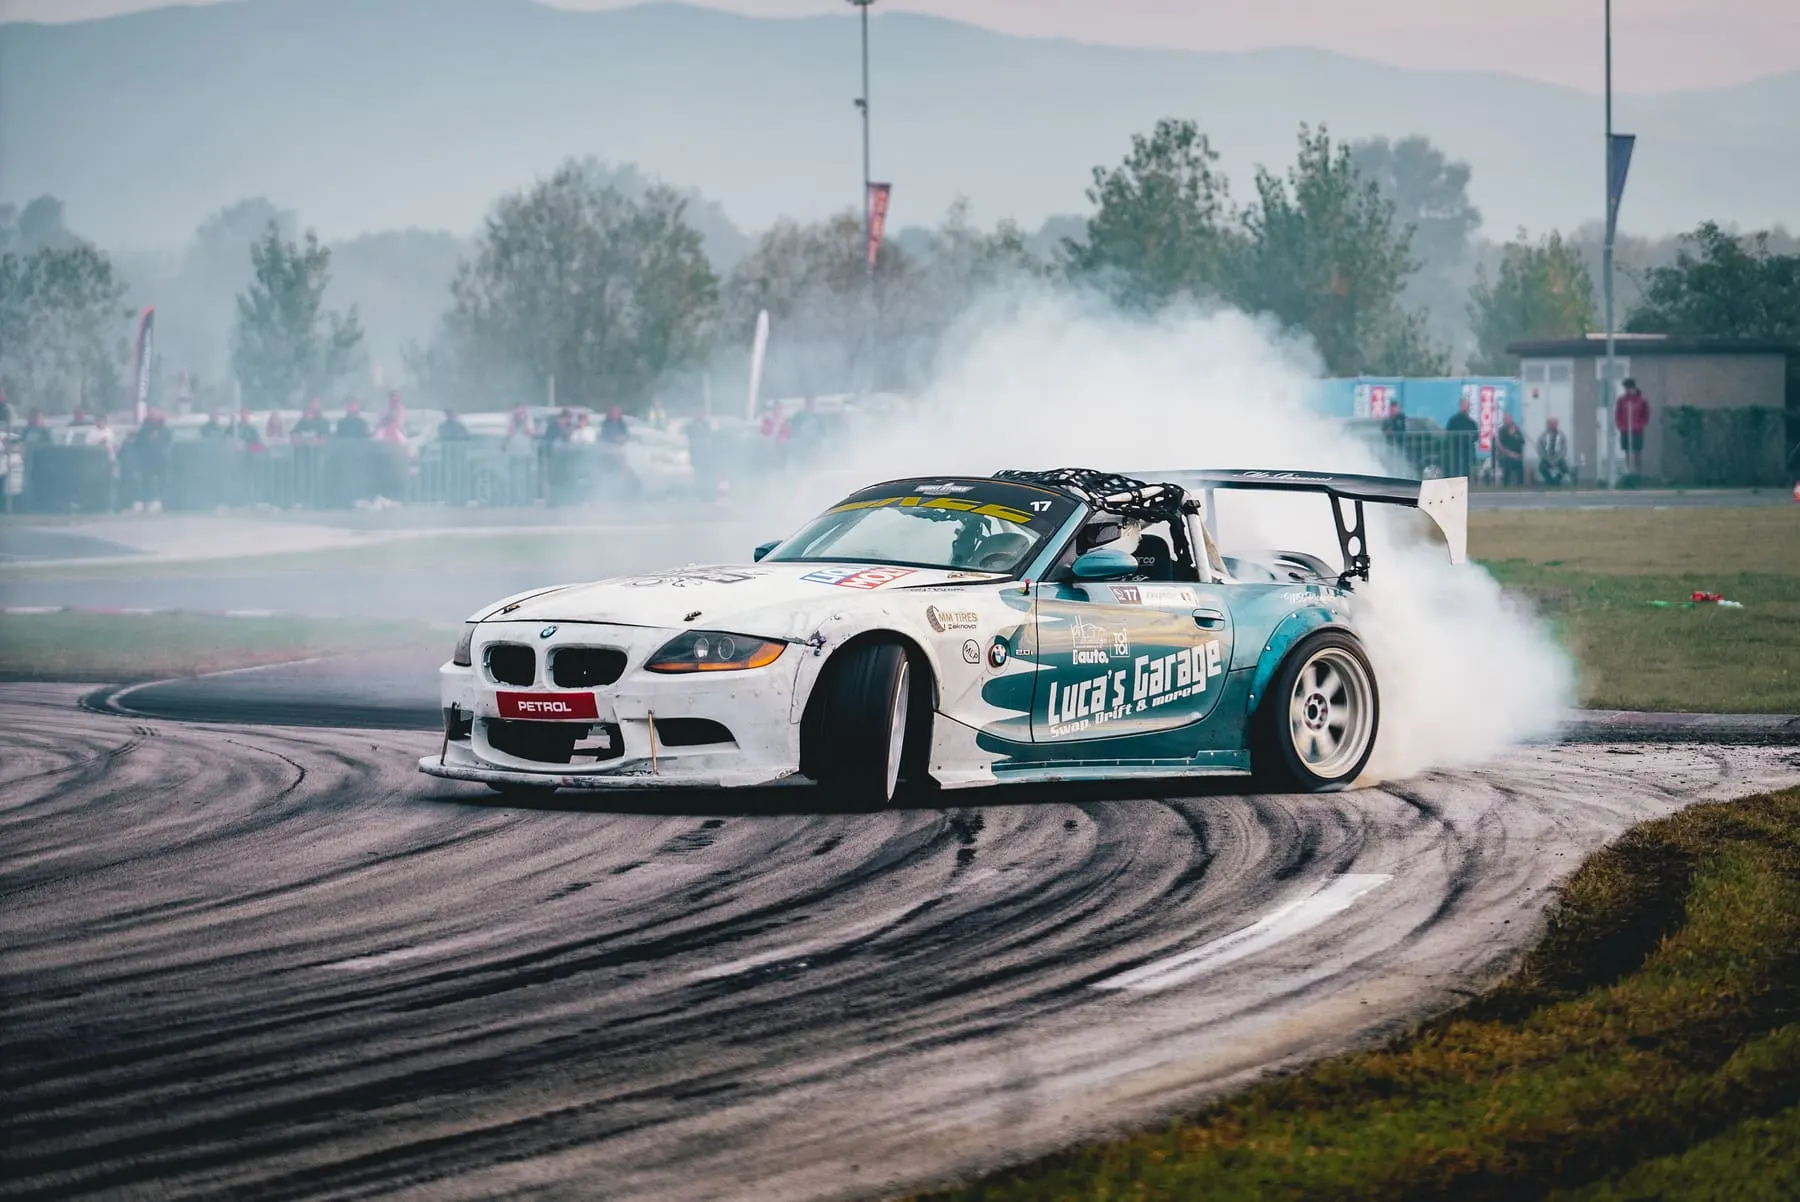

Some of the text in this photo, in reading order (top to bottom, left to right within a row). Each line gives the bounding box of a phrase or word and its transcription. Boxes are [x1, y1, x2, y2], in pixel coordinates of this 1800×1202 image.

[1030, 500, 1053, 512] 17
[1124, 589, 1138, 601] 17
[938, 612, 978, 623] MM TIRES
[1048, 639, 1222, 726] Luca's Garage
[517, 700, 572, 712] PETROL
[1095, 705, 1133, 725] Drift
[1136, 699, 1147, 713] &
[1152, 687, 1193, 707] more
